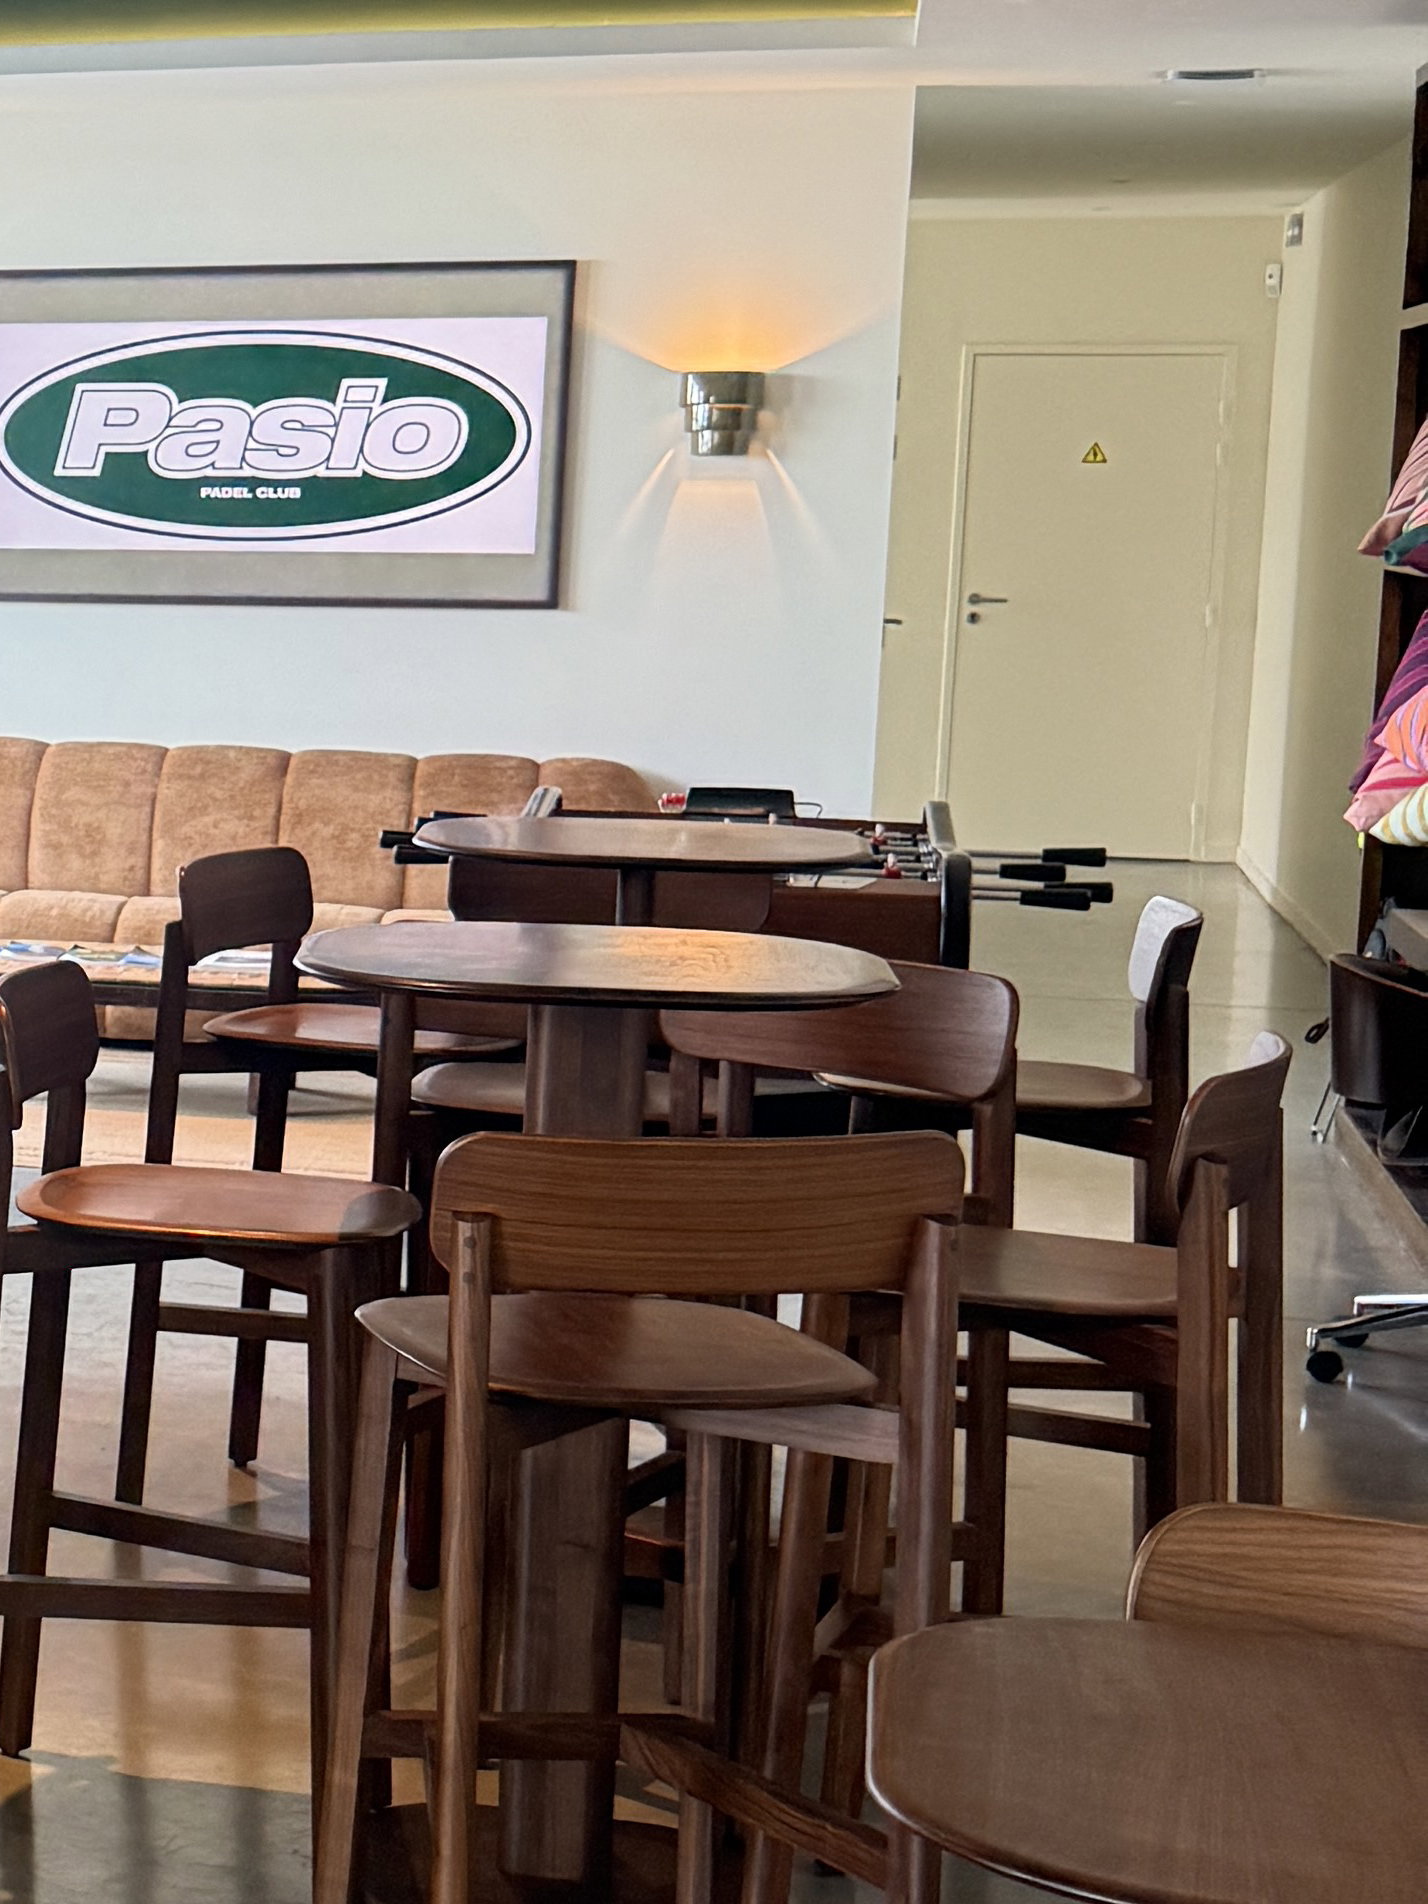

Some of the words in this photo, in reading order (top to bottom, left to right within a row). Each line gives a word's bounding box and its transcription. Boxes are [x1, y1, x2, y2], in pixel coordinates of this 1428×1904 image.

[53, 377, 469, 479] Pasio
[200, 487, 253, 499] PADEL
[255, 487, 302, 499] CLUB
